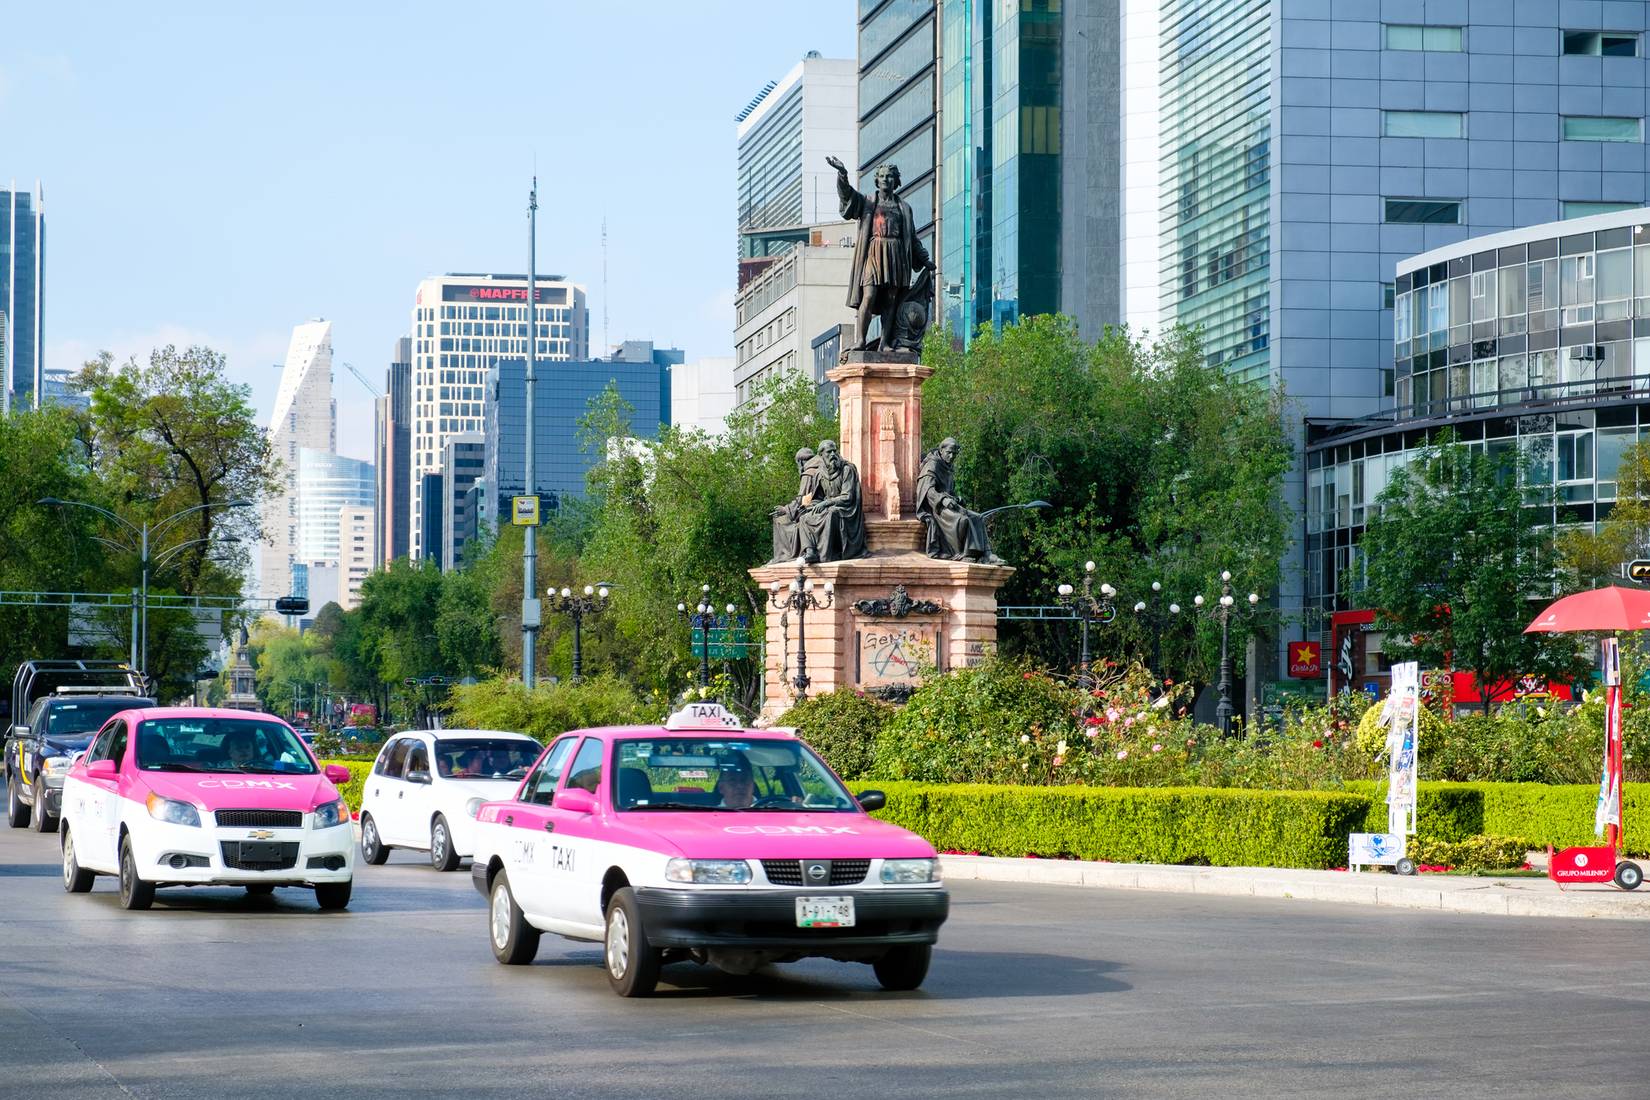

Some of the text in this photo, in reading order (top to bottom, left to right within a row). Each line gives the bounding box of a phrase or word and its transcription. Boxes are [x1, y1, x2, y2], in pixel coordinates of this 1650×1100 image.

[479, 288, 541, 300] MAPFRE
[1423, 675, 1452, 685] OO
[691, 705, 721, 718] TAXI
[197, 779, 298, 791] CDMX
[723, 825, 861, 835] CDMX
[552, 845, 576, 872] TAXI
